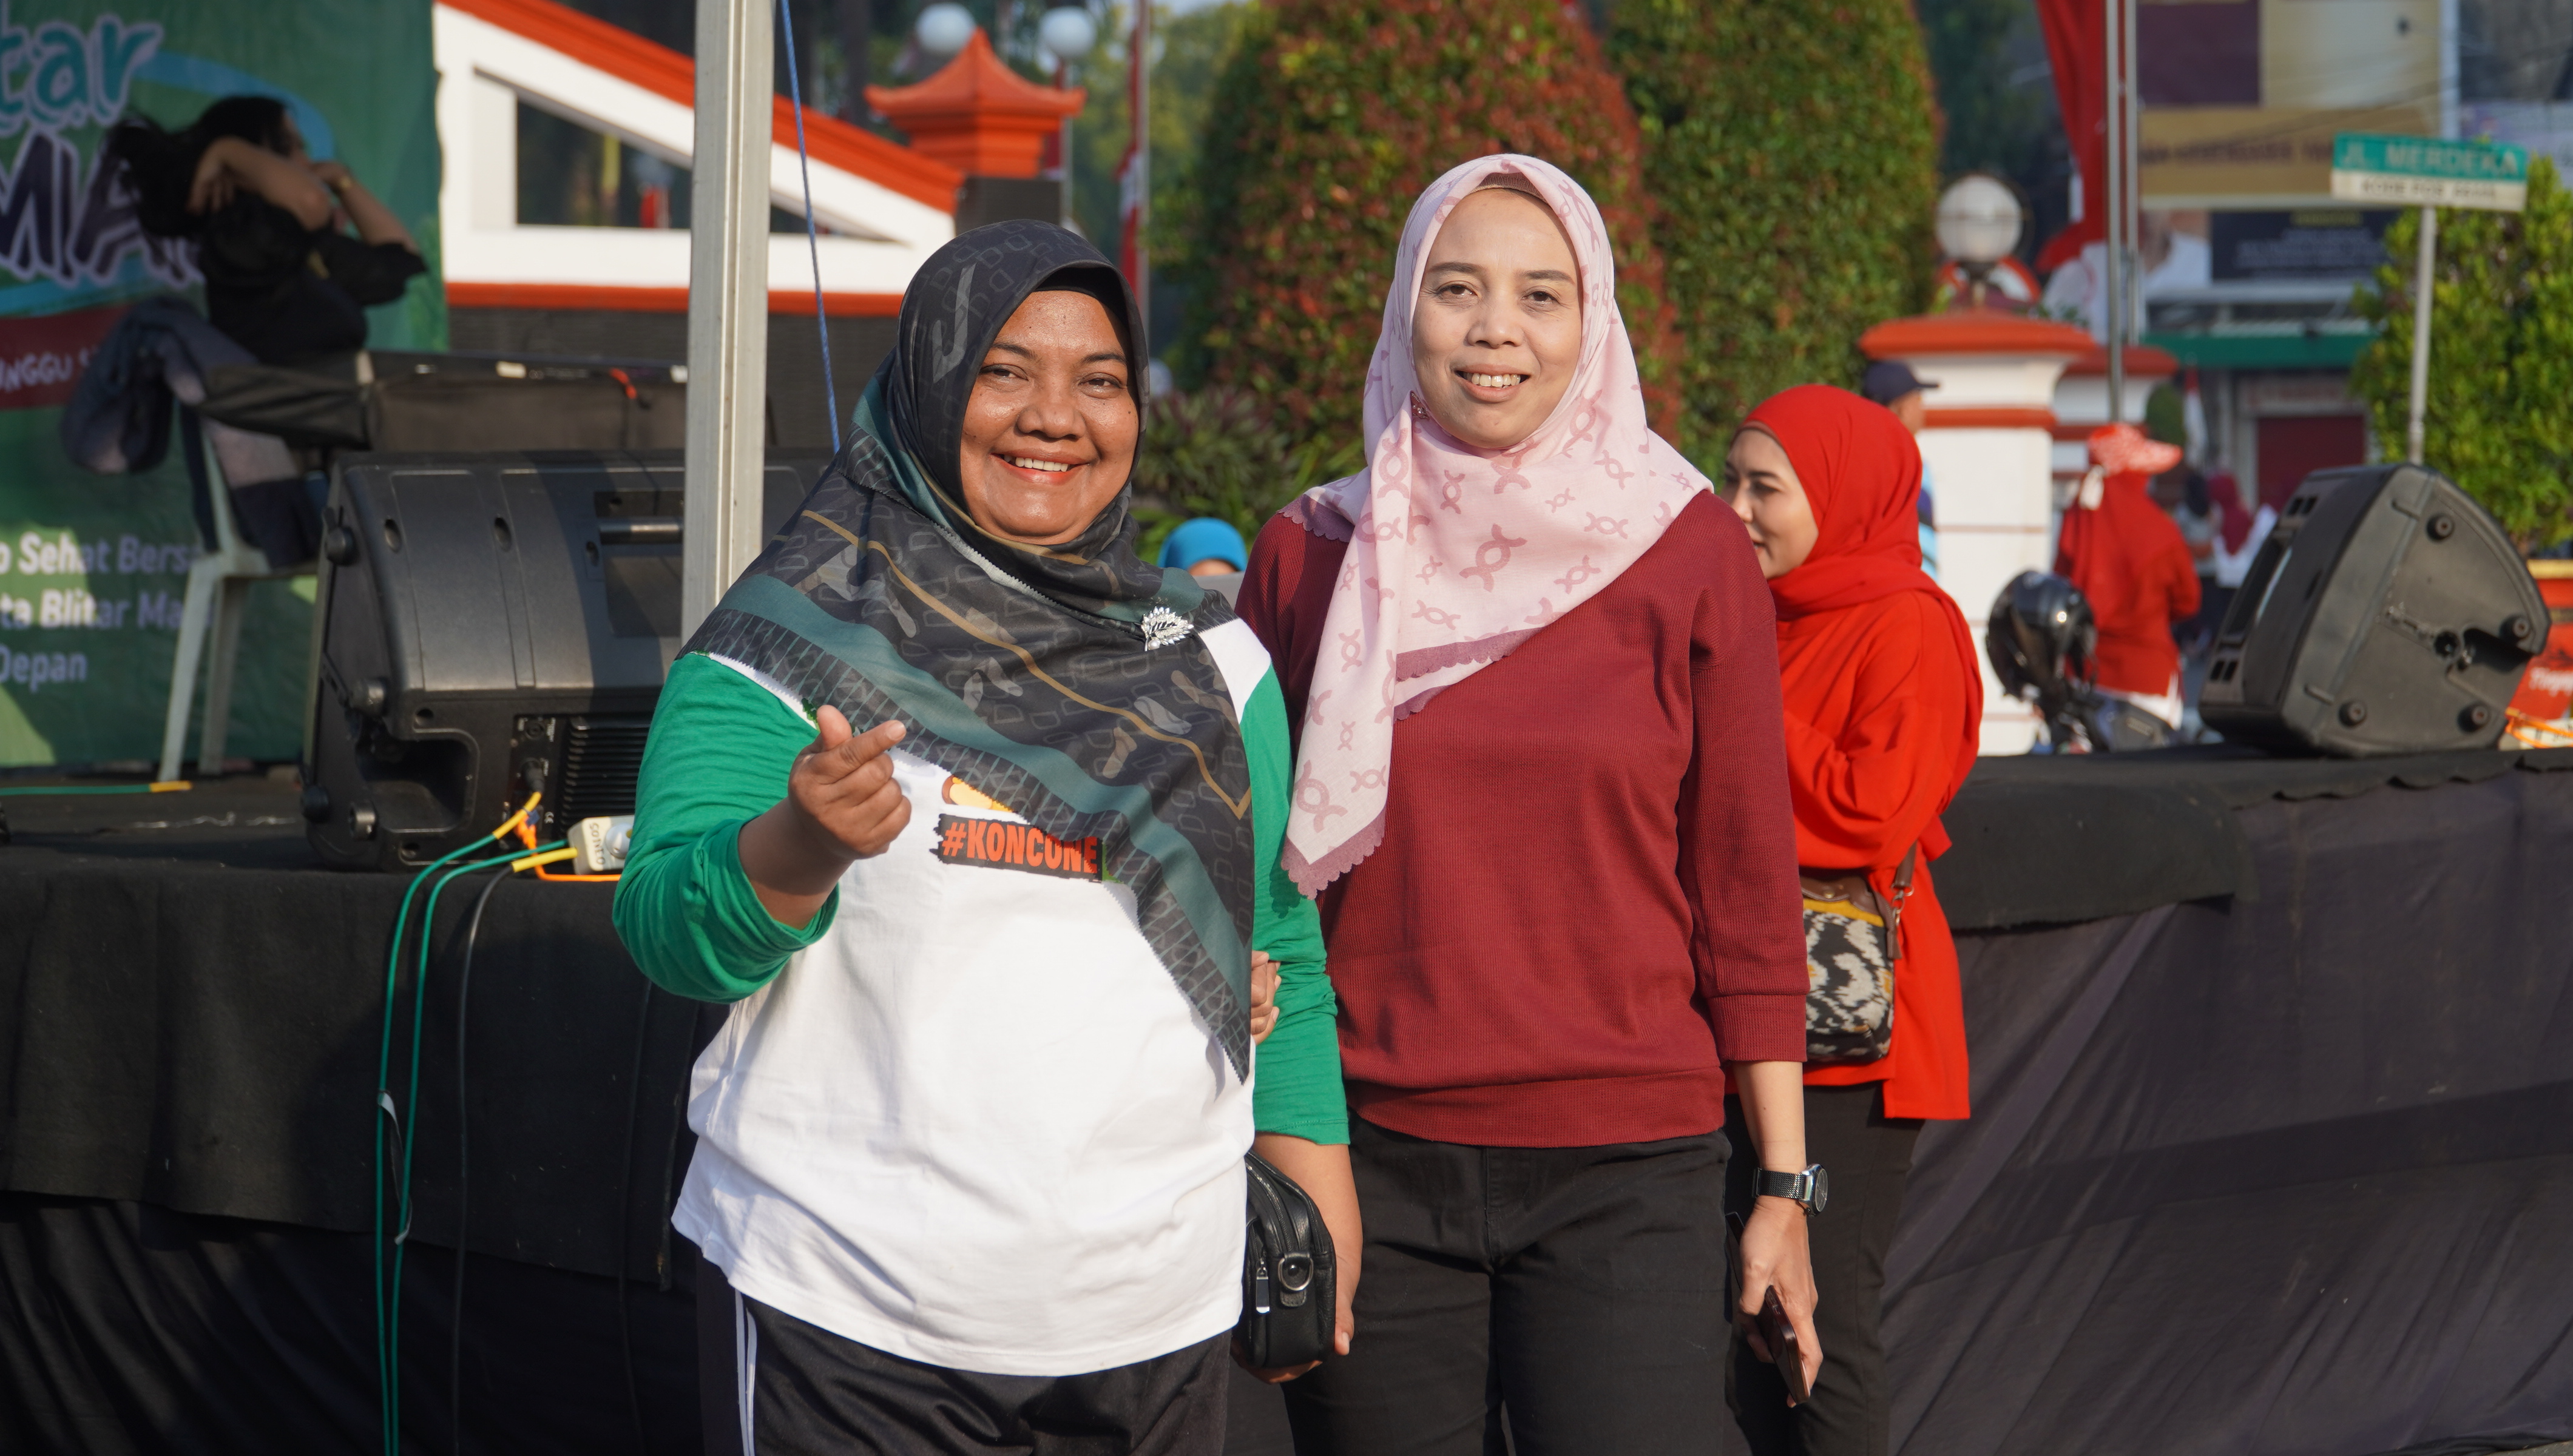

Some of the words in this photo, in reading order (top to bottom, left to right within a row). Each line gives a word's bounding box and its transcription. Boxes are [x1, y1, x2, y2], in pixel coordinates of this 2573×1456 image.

[2385, 143, 2519, 177] MERDEKA
[18, 531, 111, 576] Sehat
[117, 533, 202, 575] Bers
[39, 587, 131, 630] Blitar
[941, 819, 1098, 874] #KONCONE
